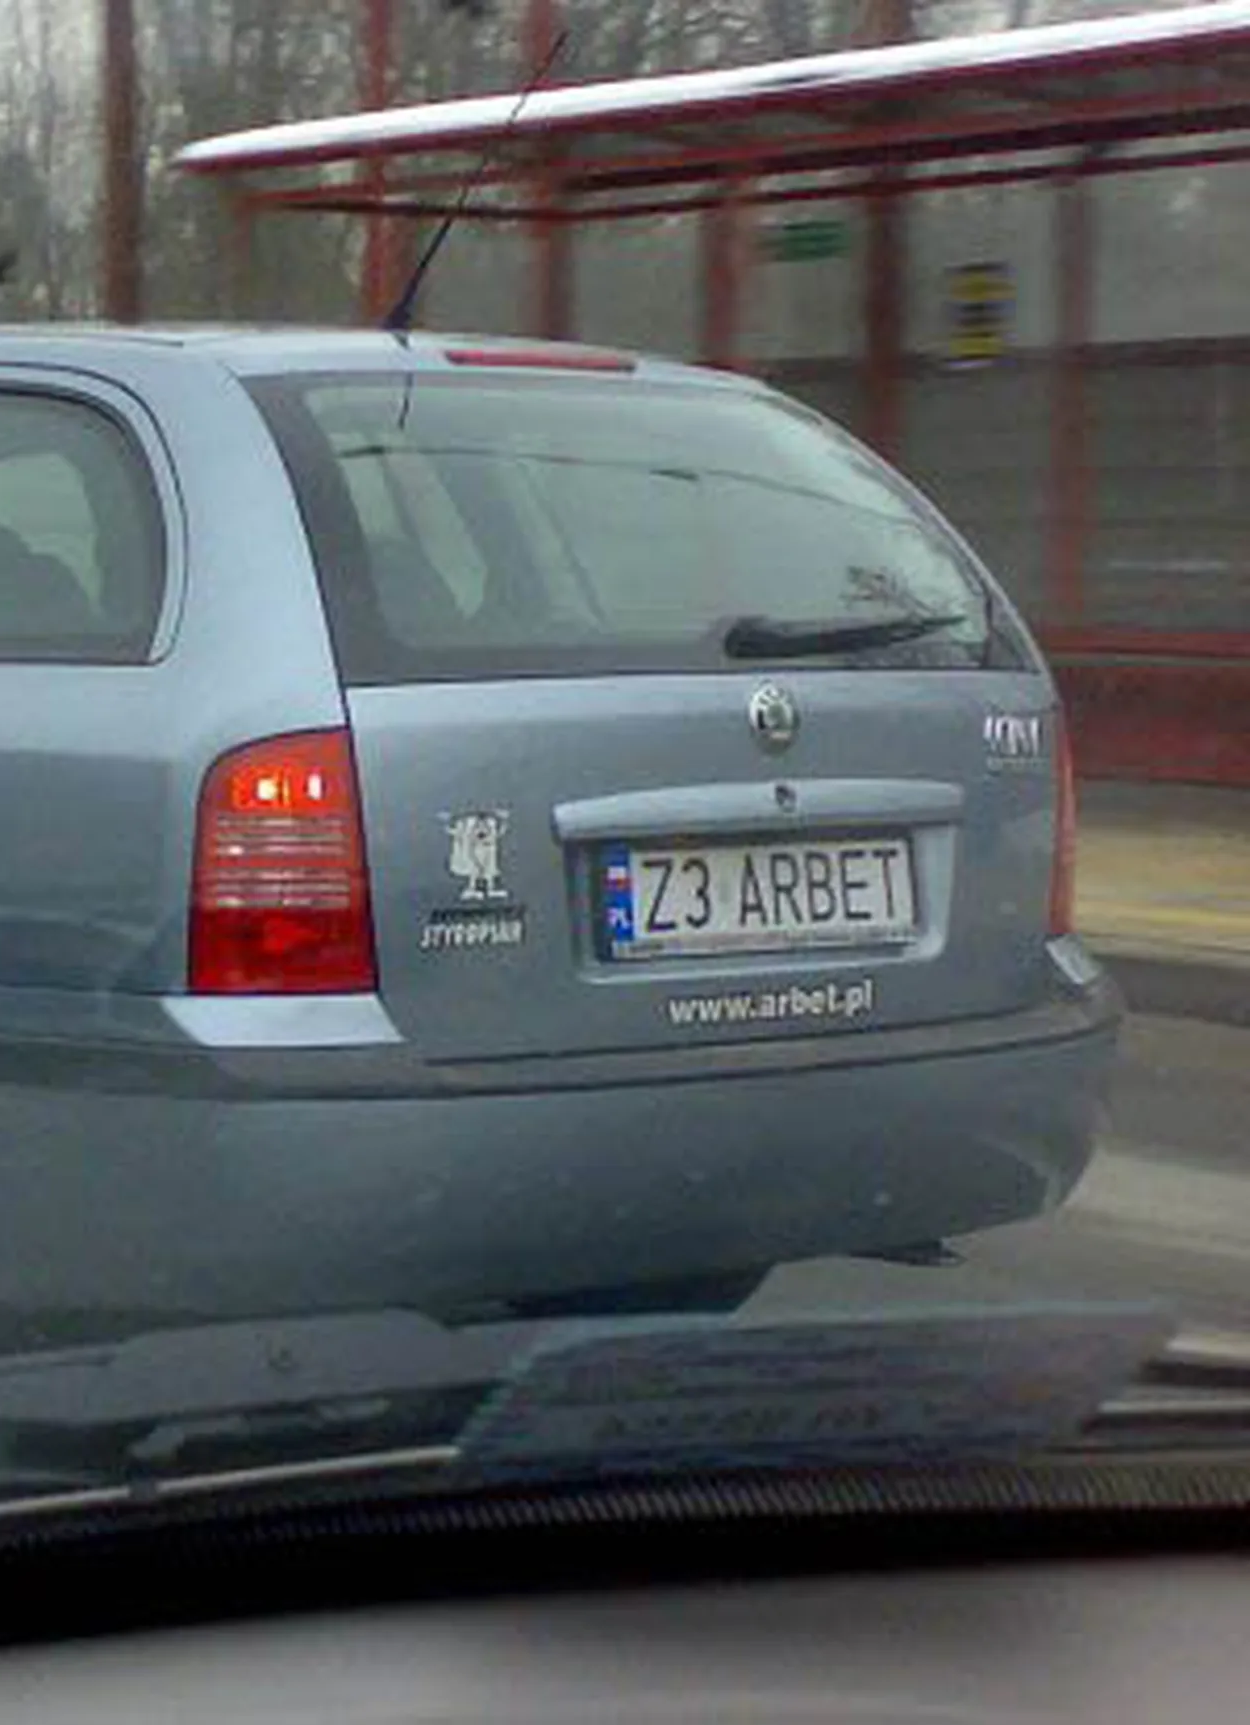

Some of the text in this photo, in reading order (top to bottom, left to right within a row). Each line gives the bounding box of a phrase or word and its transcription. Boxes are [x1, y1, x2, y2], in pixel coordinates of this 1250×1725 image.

[642, 849, 899, 933] Z3 ARBET
[668, 979, 873, 1023] www.arbet.pl
